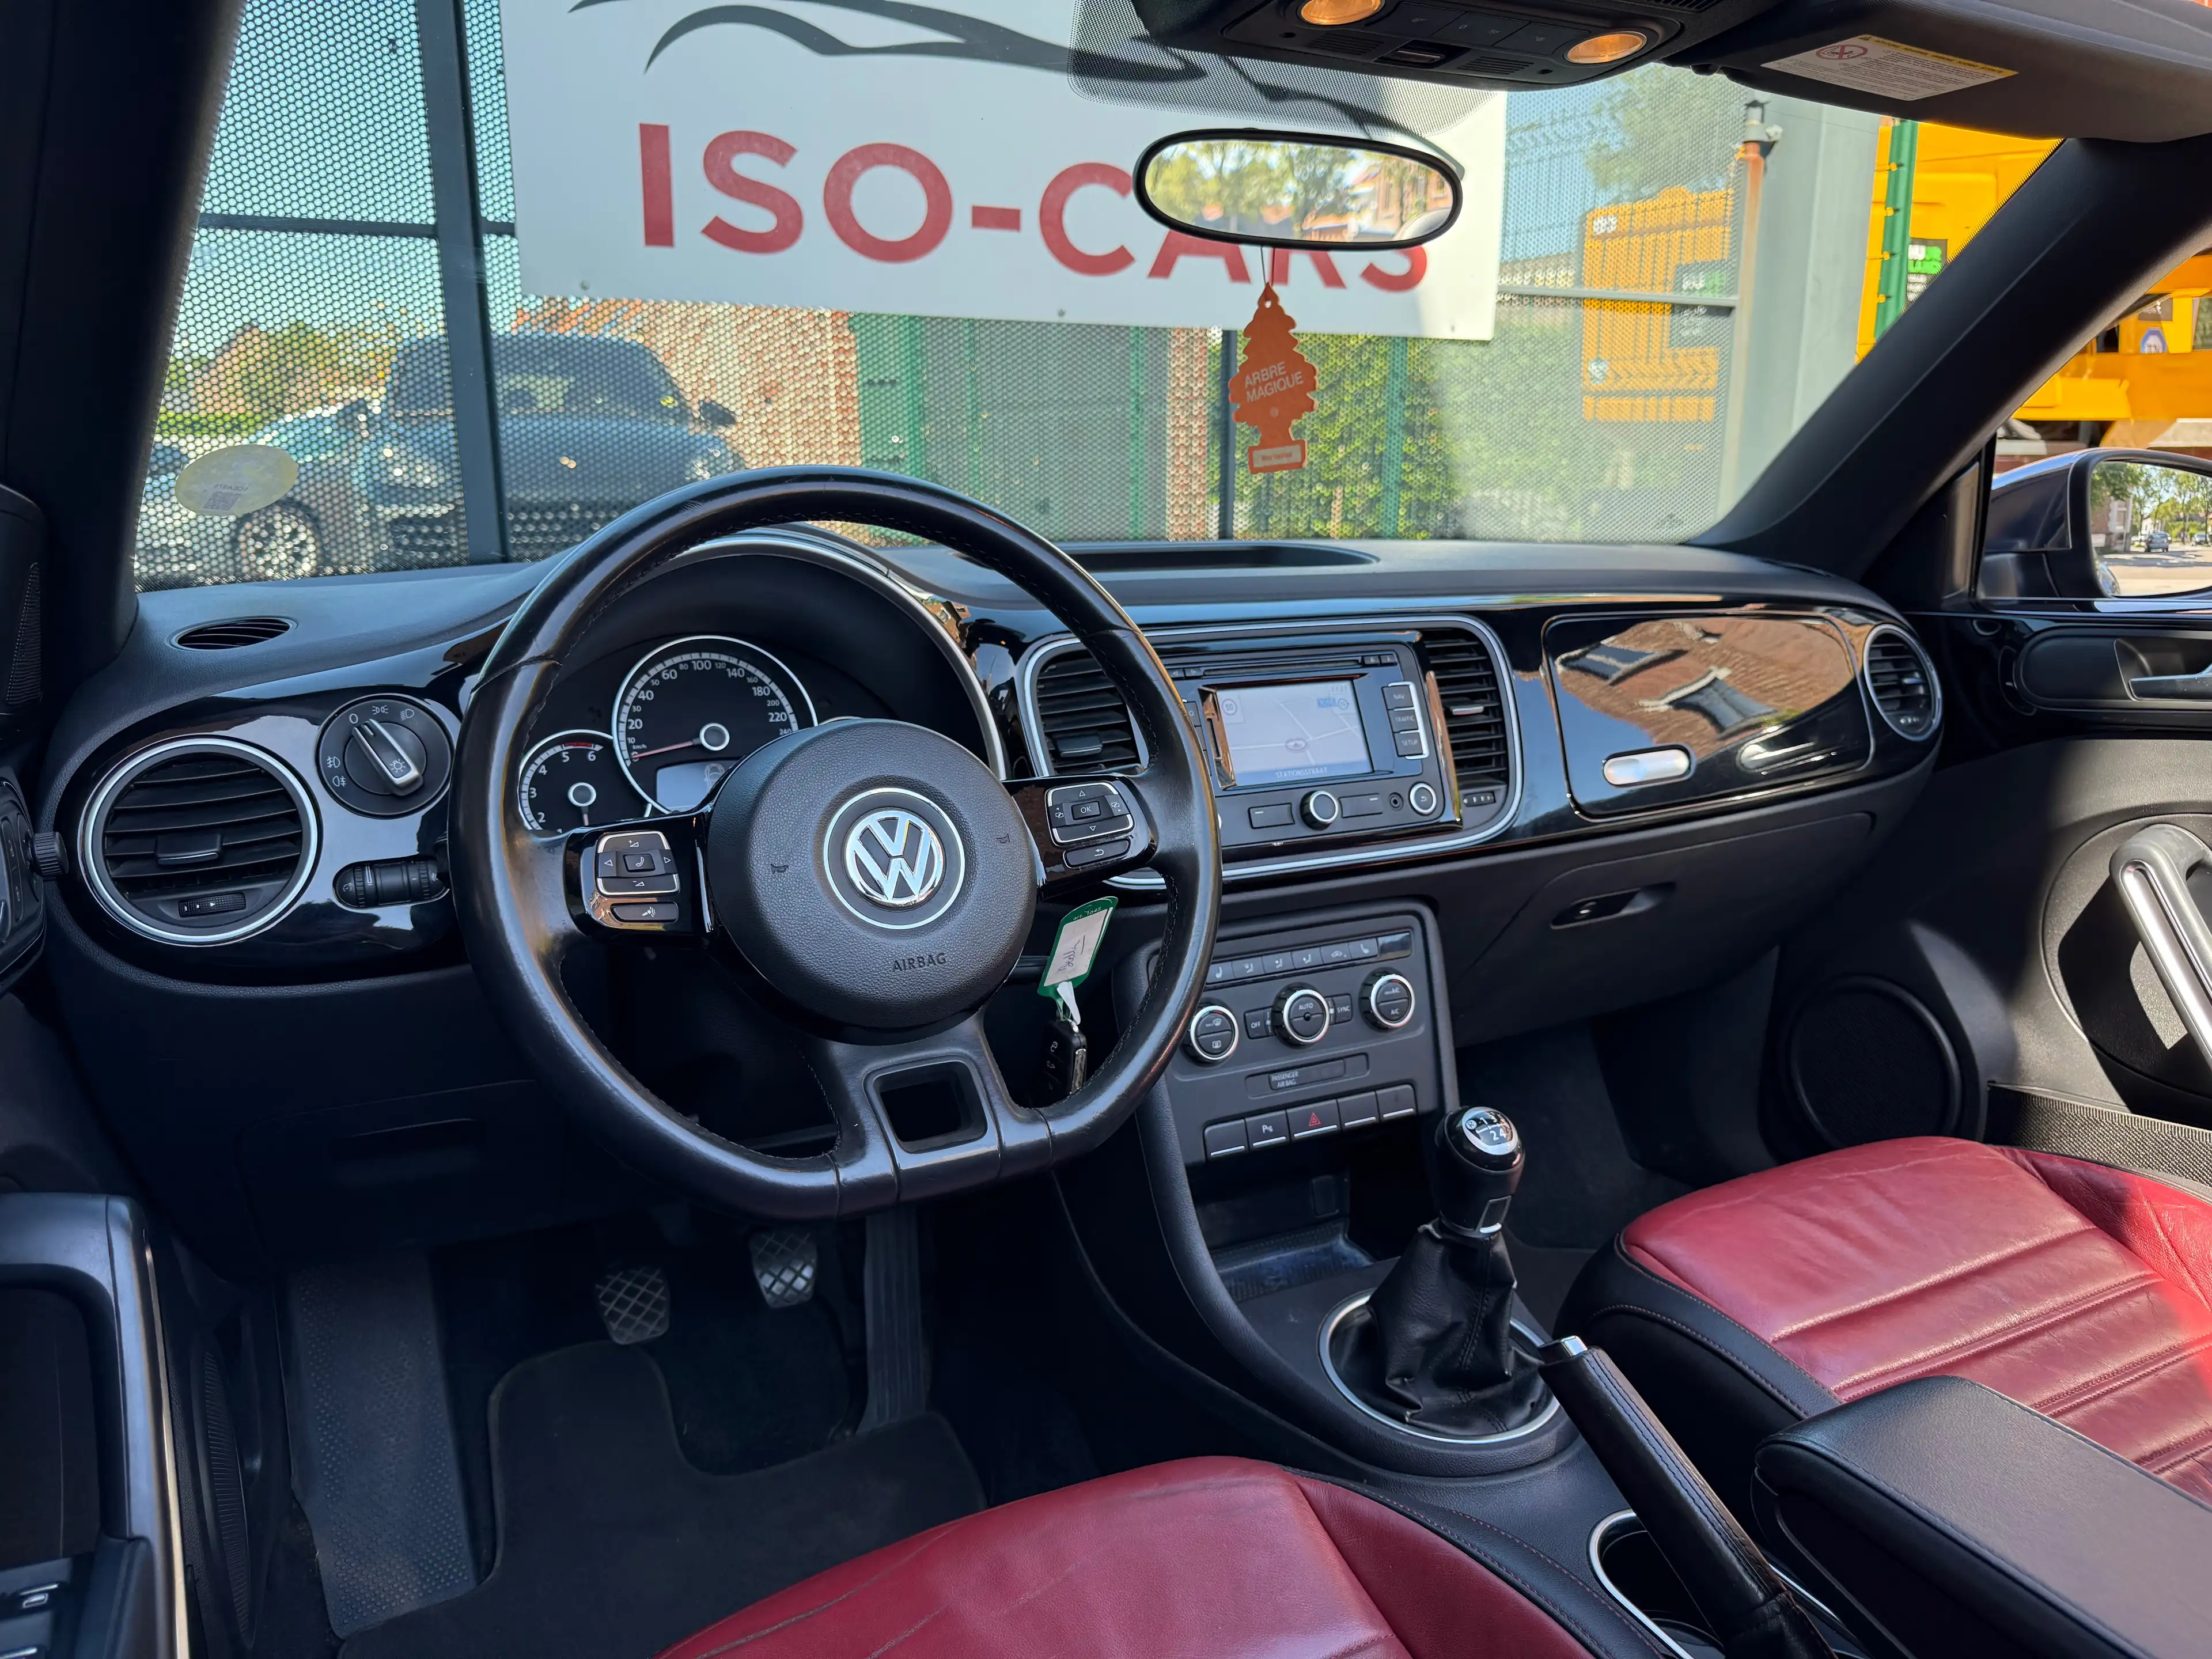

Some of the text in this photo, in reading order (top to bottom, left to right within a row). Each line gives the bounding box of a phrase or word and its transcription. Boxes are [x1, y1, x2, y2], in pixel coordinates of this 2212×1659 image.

[639, 123, 1427, 293] ISO-C
[1244, 361, 1286, 389] ARBRE
[1246, 372, 1304, 403] MAGIQUE
[692, 660, 712, 671] 100
[661, 669, 677, 680] 60
[726, 668, 745, 678] 140
[638, 690, 654, 701] 40
[752, 686, 770, 696] 180
[1225, 703, 1233, 711] 50
[768, 712, 787, 722] 220
[628, 718, 643, 730] 20
[562, 751, 570, 763] 5
[587, 751, 596, 762] 6
[539, 764, 548, 775] 4
[529, 787, 537, 798] 3
[537, 812, 546, 823] 2
[892, 953, 947, 973] AIRBAG
[1298, 1002, 1314, 1011] AUTO
[1251, 1021, 1261, 1029] OFF
[1271, 1070, 1300, 1082] PASSENGER
[1479, 1117, 1488, 1125] 1
[1490, 1128, 1506, 1141] 2 4
